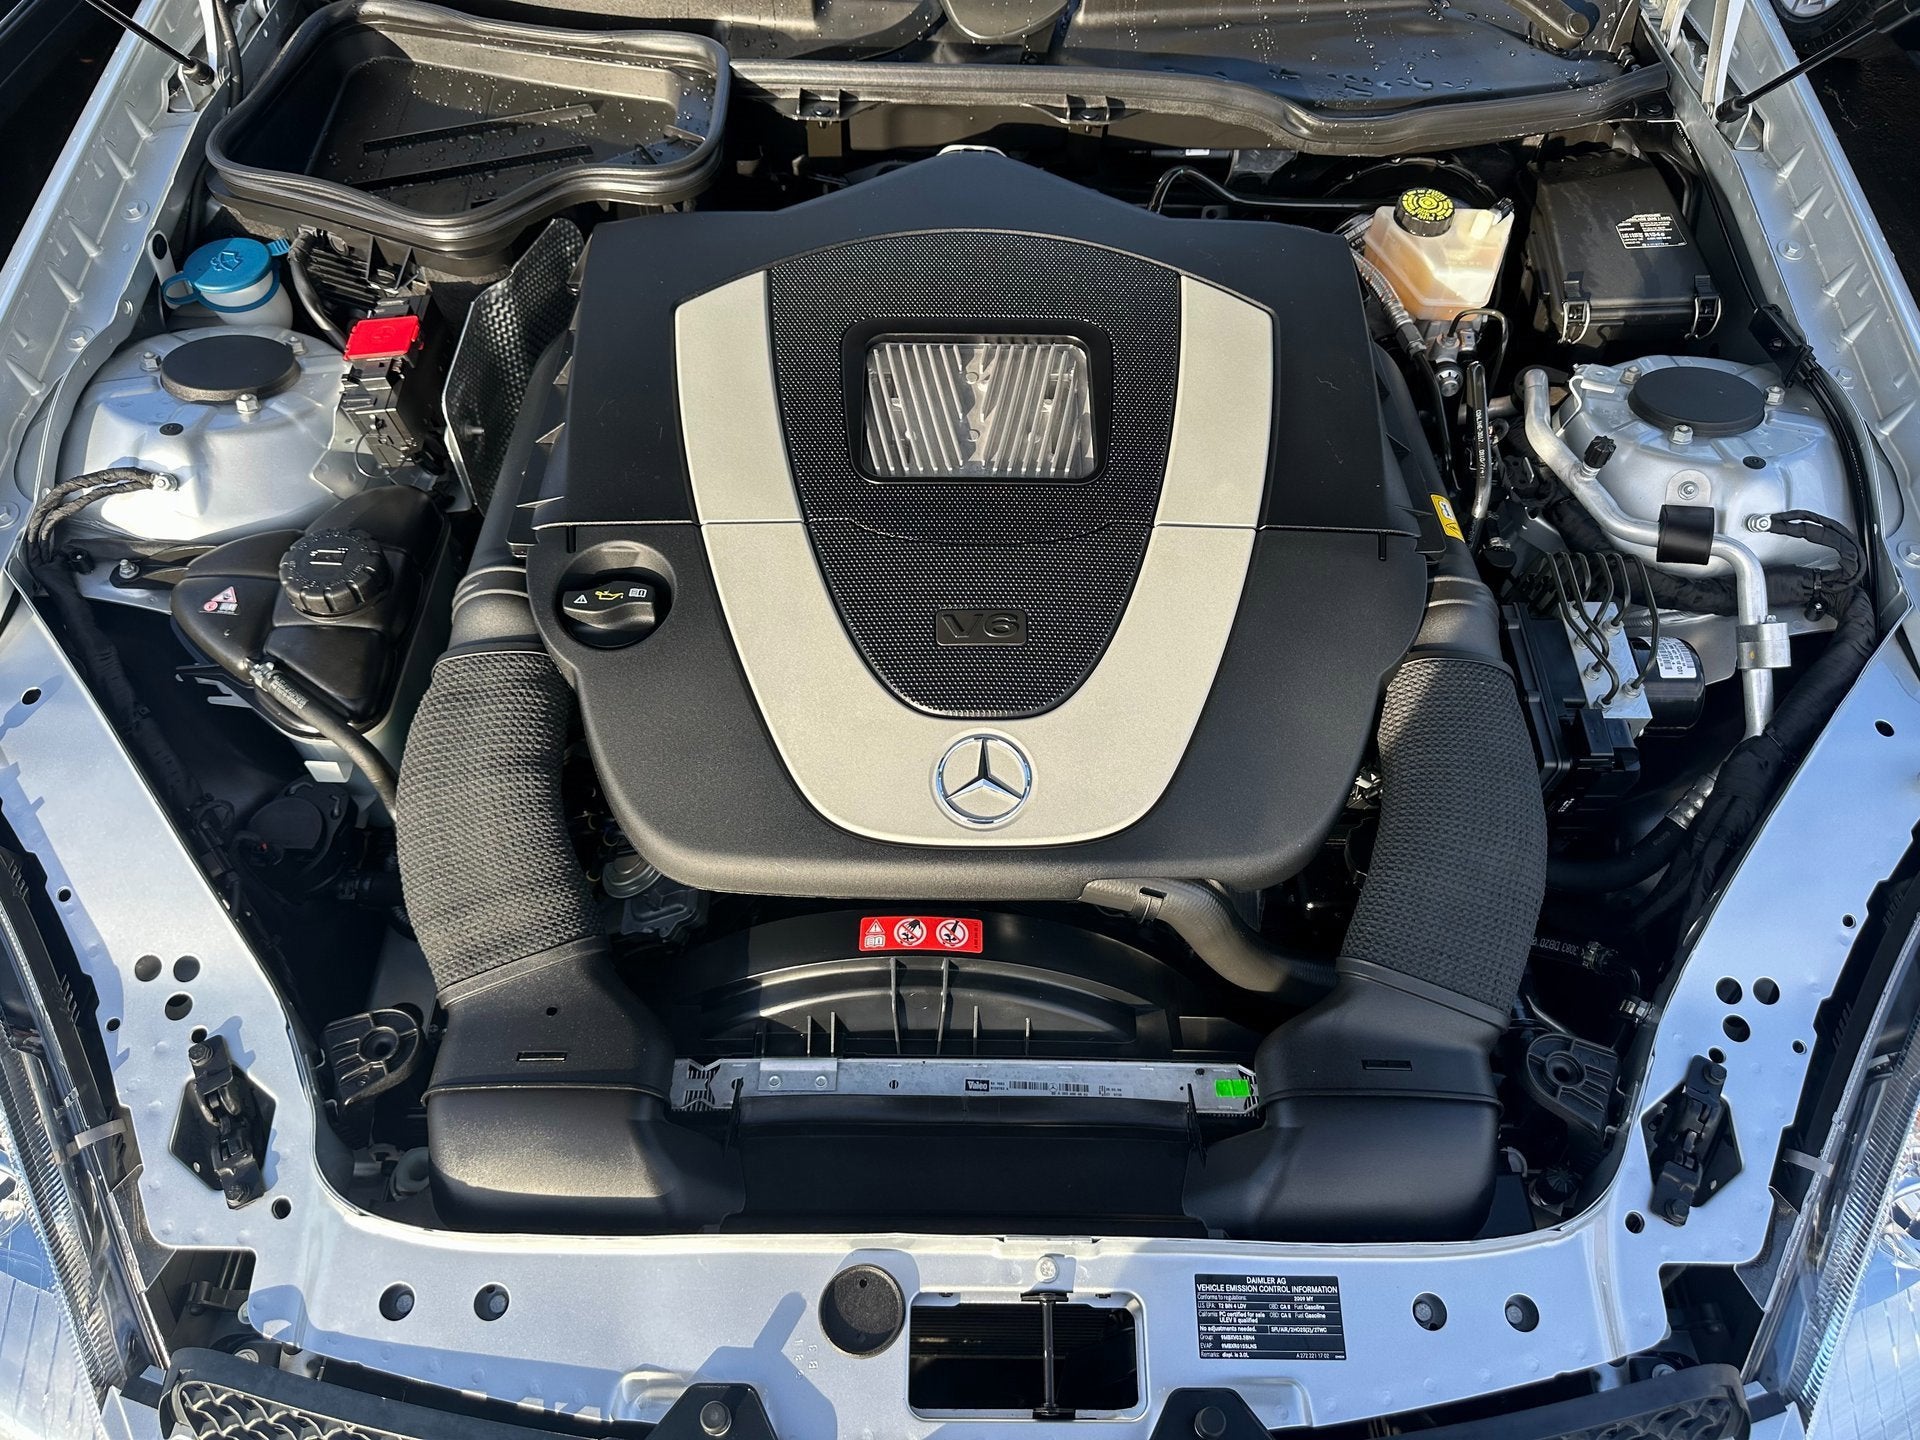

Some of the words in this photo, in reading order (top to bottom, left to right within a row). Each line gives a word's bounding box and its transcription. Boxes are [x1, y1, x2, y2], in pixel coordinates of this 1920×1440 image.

[941, 612, 1020, 638] V6
[1246, 1276, 1276, 1284] DAIMLER
[1196, 1284, 1225, 1292] VEHICLE
[1226, 1284, 1258, 1292] EMISSION
[1259, 1285, 1290, 1293] CONTROL
[1292, 1286, 1338, 1294] INFORMATION
